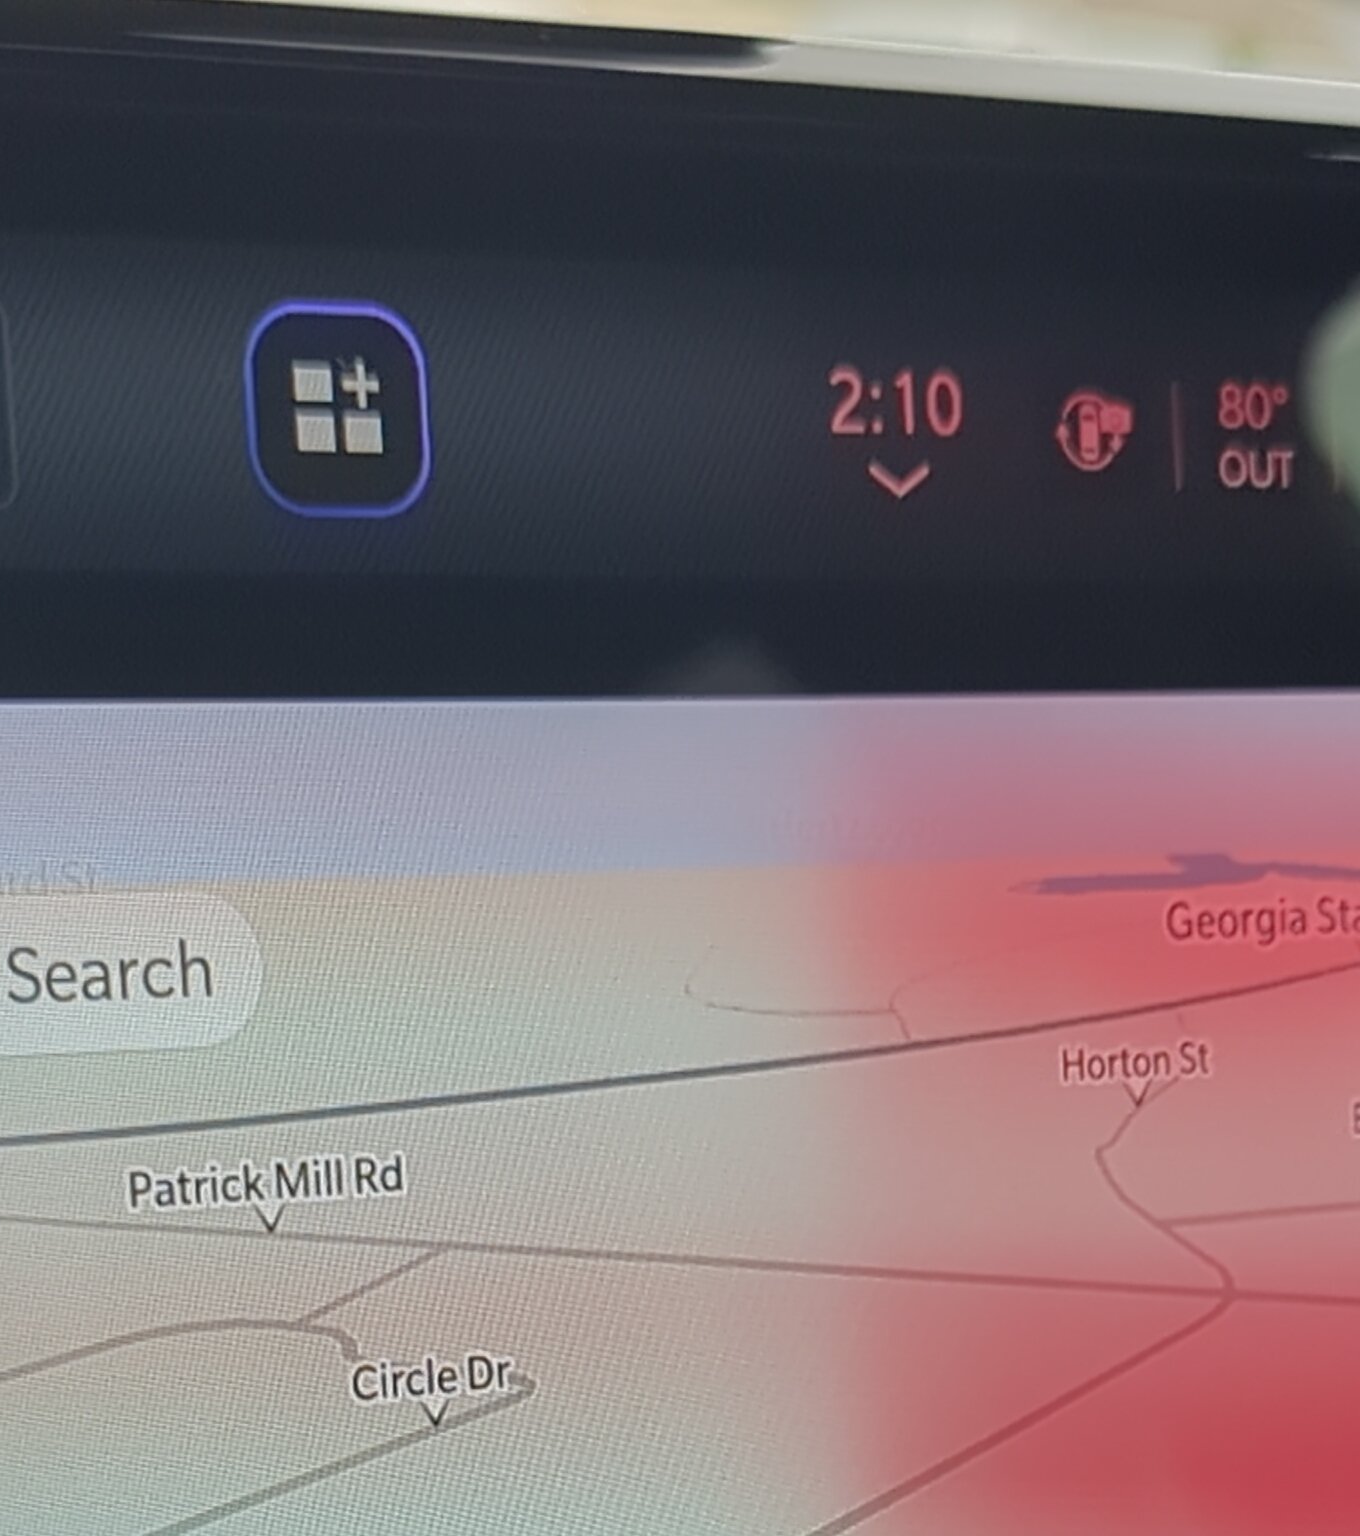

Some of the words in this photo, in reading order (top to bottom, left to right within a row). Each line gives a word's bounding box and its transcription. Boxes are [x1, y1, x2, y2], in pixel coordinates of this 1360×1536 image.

[828, 365, 964, 437] 2:10
[1218, 448, 1293, 488] OUT
[1165, 897, 1308, 945] Georgia
[6, 937, 214, 1004] Search
[1061, 1046, 1172, 1084] Horton
[1180, 1042, 1210, 1077] St
[129, 1164, 266, 1208] Patrick
[275, 1160, 342, 1200] Mill
[354, 1155, 404, 1193] Rd
[352, 1358, 457, 1399] Circle
[468, 1355, 511, 1390] Dr
